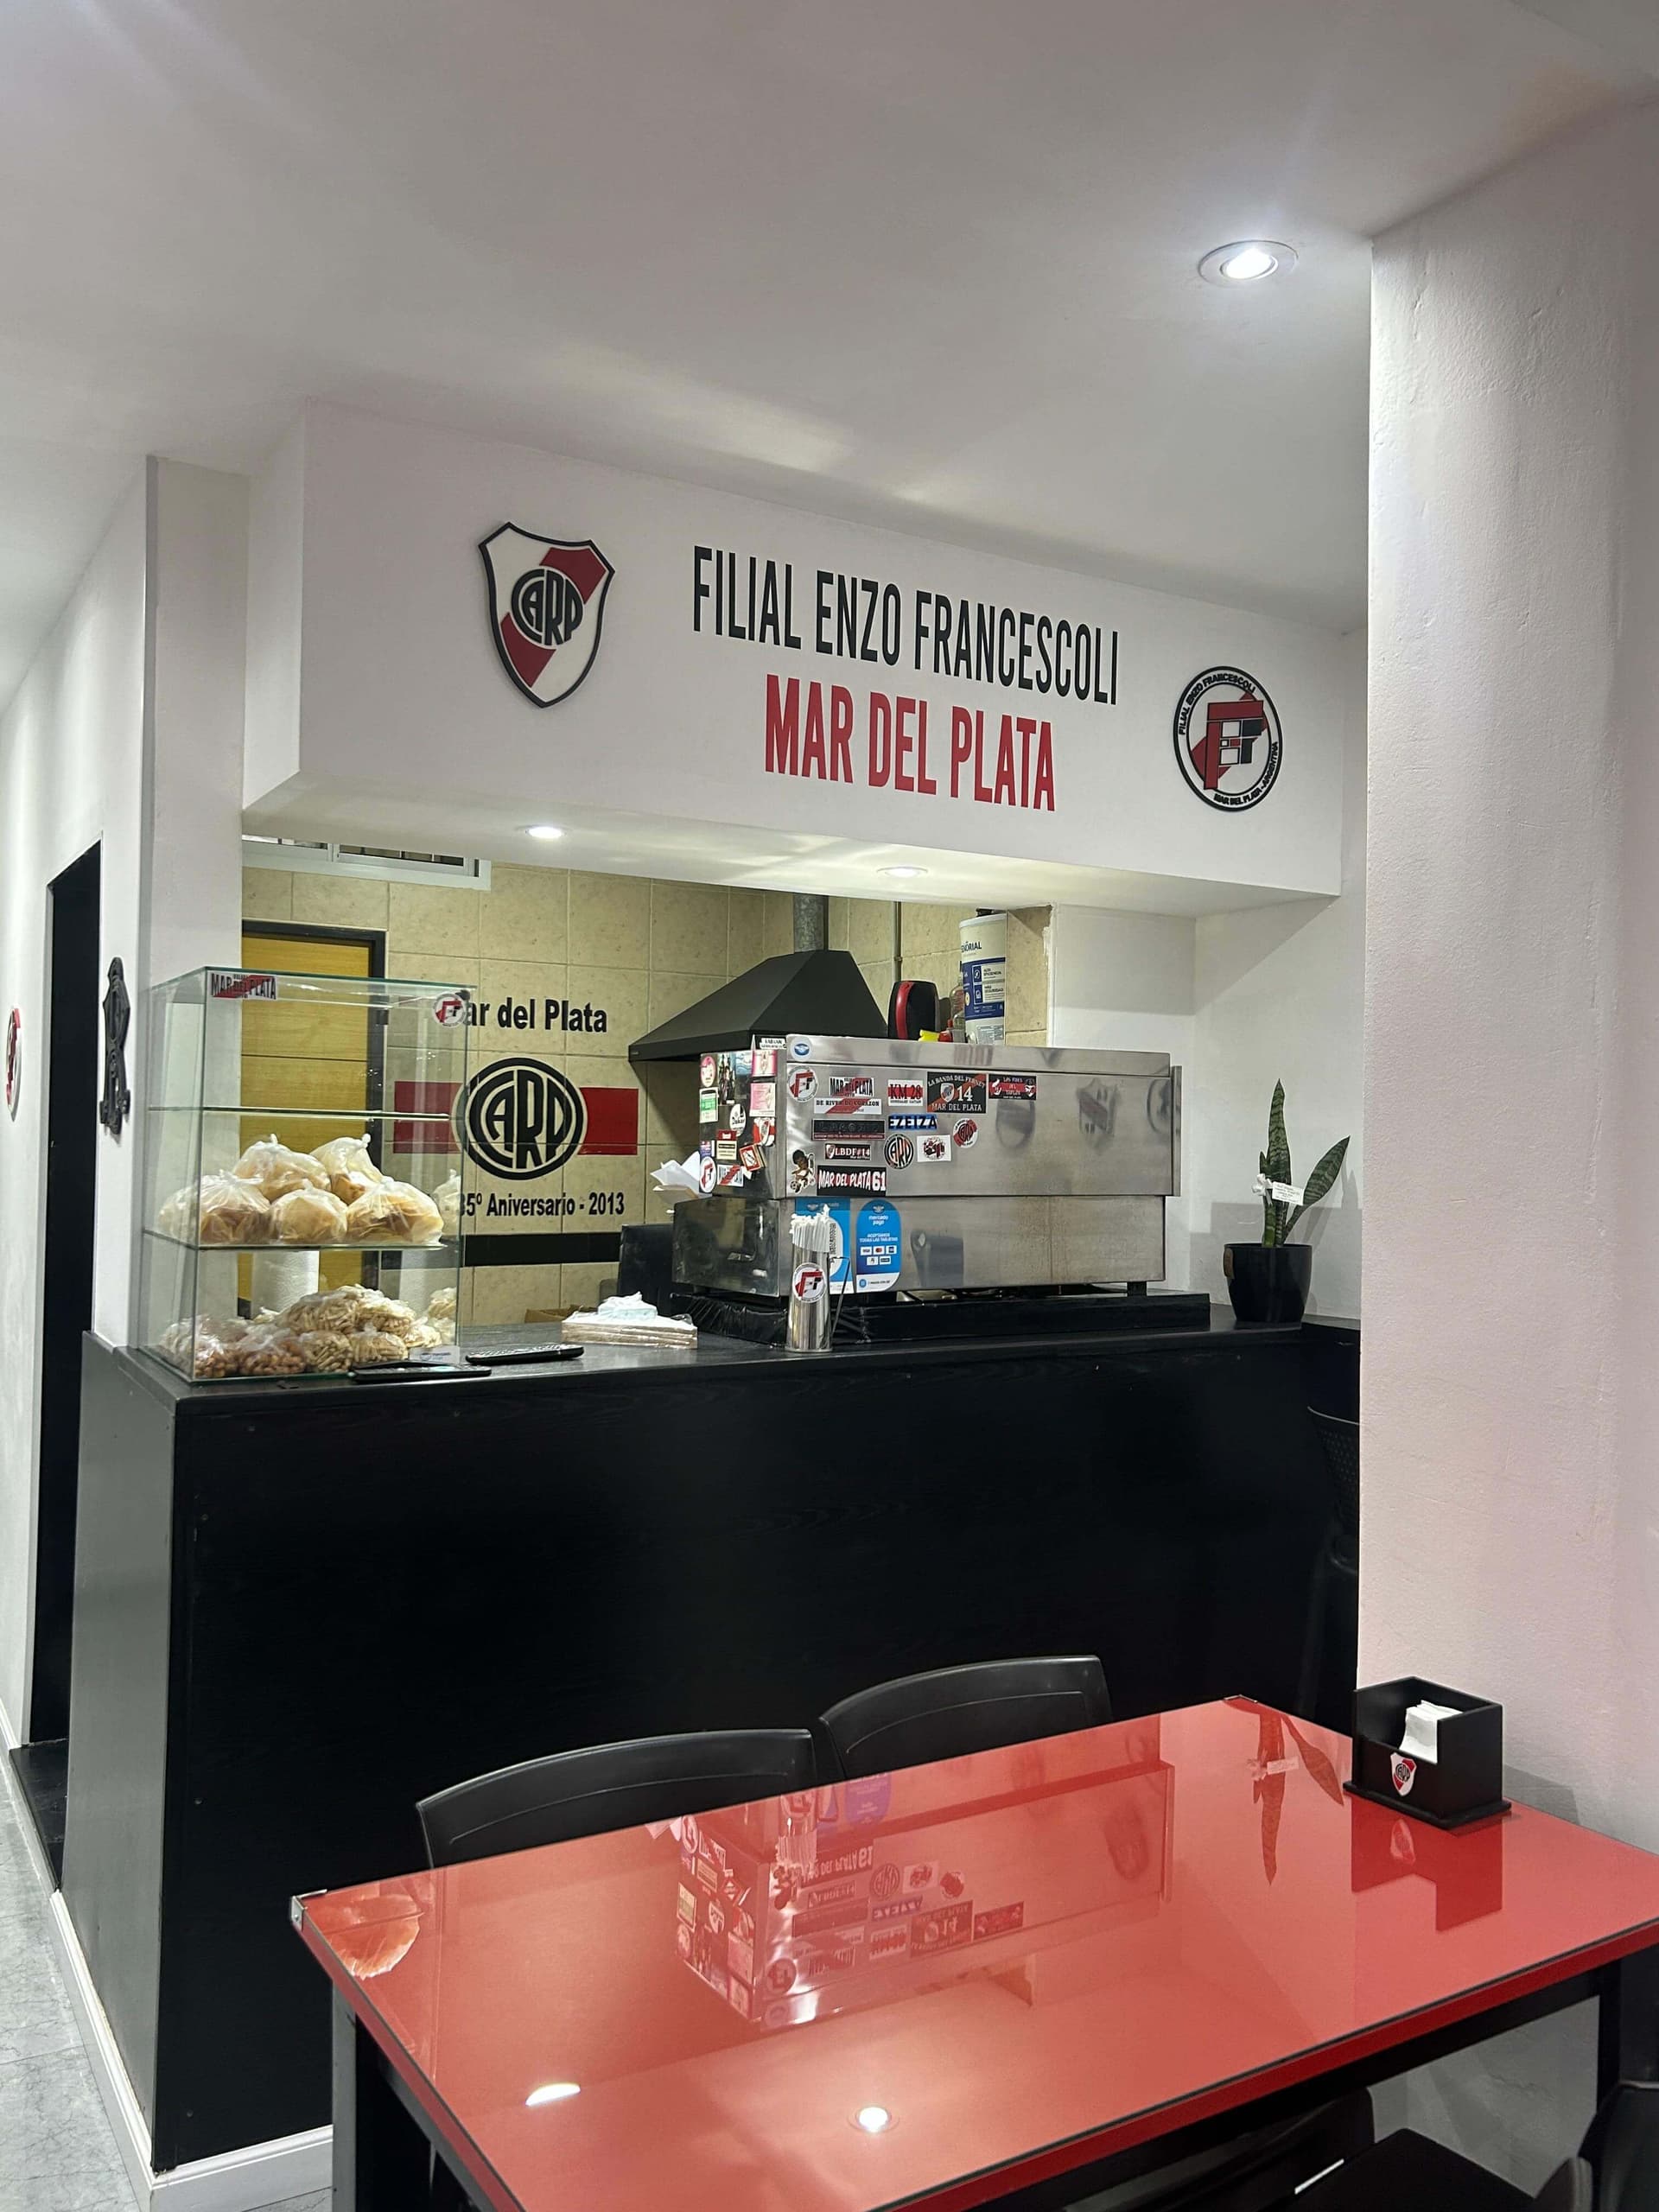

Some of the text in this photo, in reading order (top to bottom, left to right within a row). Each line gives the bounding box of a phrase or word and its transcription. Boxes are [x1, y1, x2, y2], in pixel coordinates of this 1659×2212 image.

[511, 568, 584, 646] CARP
[694, 545, 1118, 706] FILIAL ENZO FRANCESCOLI
[1178, 673, 1256, 735] FILIAL ENZO FRANCESCOLI
[766, 674, 1055, 812] MAR DEL PLATA
[1213, 793, 1230, 805] MAR
[1230, 797, 1243, 805] DEL
[1243, 787, 1262, 804] PLATA
[211, 973, 232, 996] MAR
[249, 977, 276, 1000] PLATA
[498, 997, 535, 1029] del
[544, 999, 607, 1033] Plata
[830, 1077, 844, 1096] MAR
[855, 1077, 874, 1096] PLATA
[934, 1075, 954, 1084] BANDA
[890, 1084, 921, 1100] KM 28
[957, 1085, 973, 1102] 14
[931, 1103, 946, 1111] MAR
[948, 1103, 961, 1111] DEL
[469, 1069, 574, 1169] CARP
[889, 1116, 938, 1129] EZEIZA
[818, 1169, 887, 1191] MAR DEL PLATA 61
[486, 1192, 575, 1217] Aniversario
[588, 1192, 625, 1215] 2013
